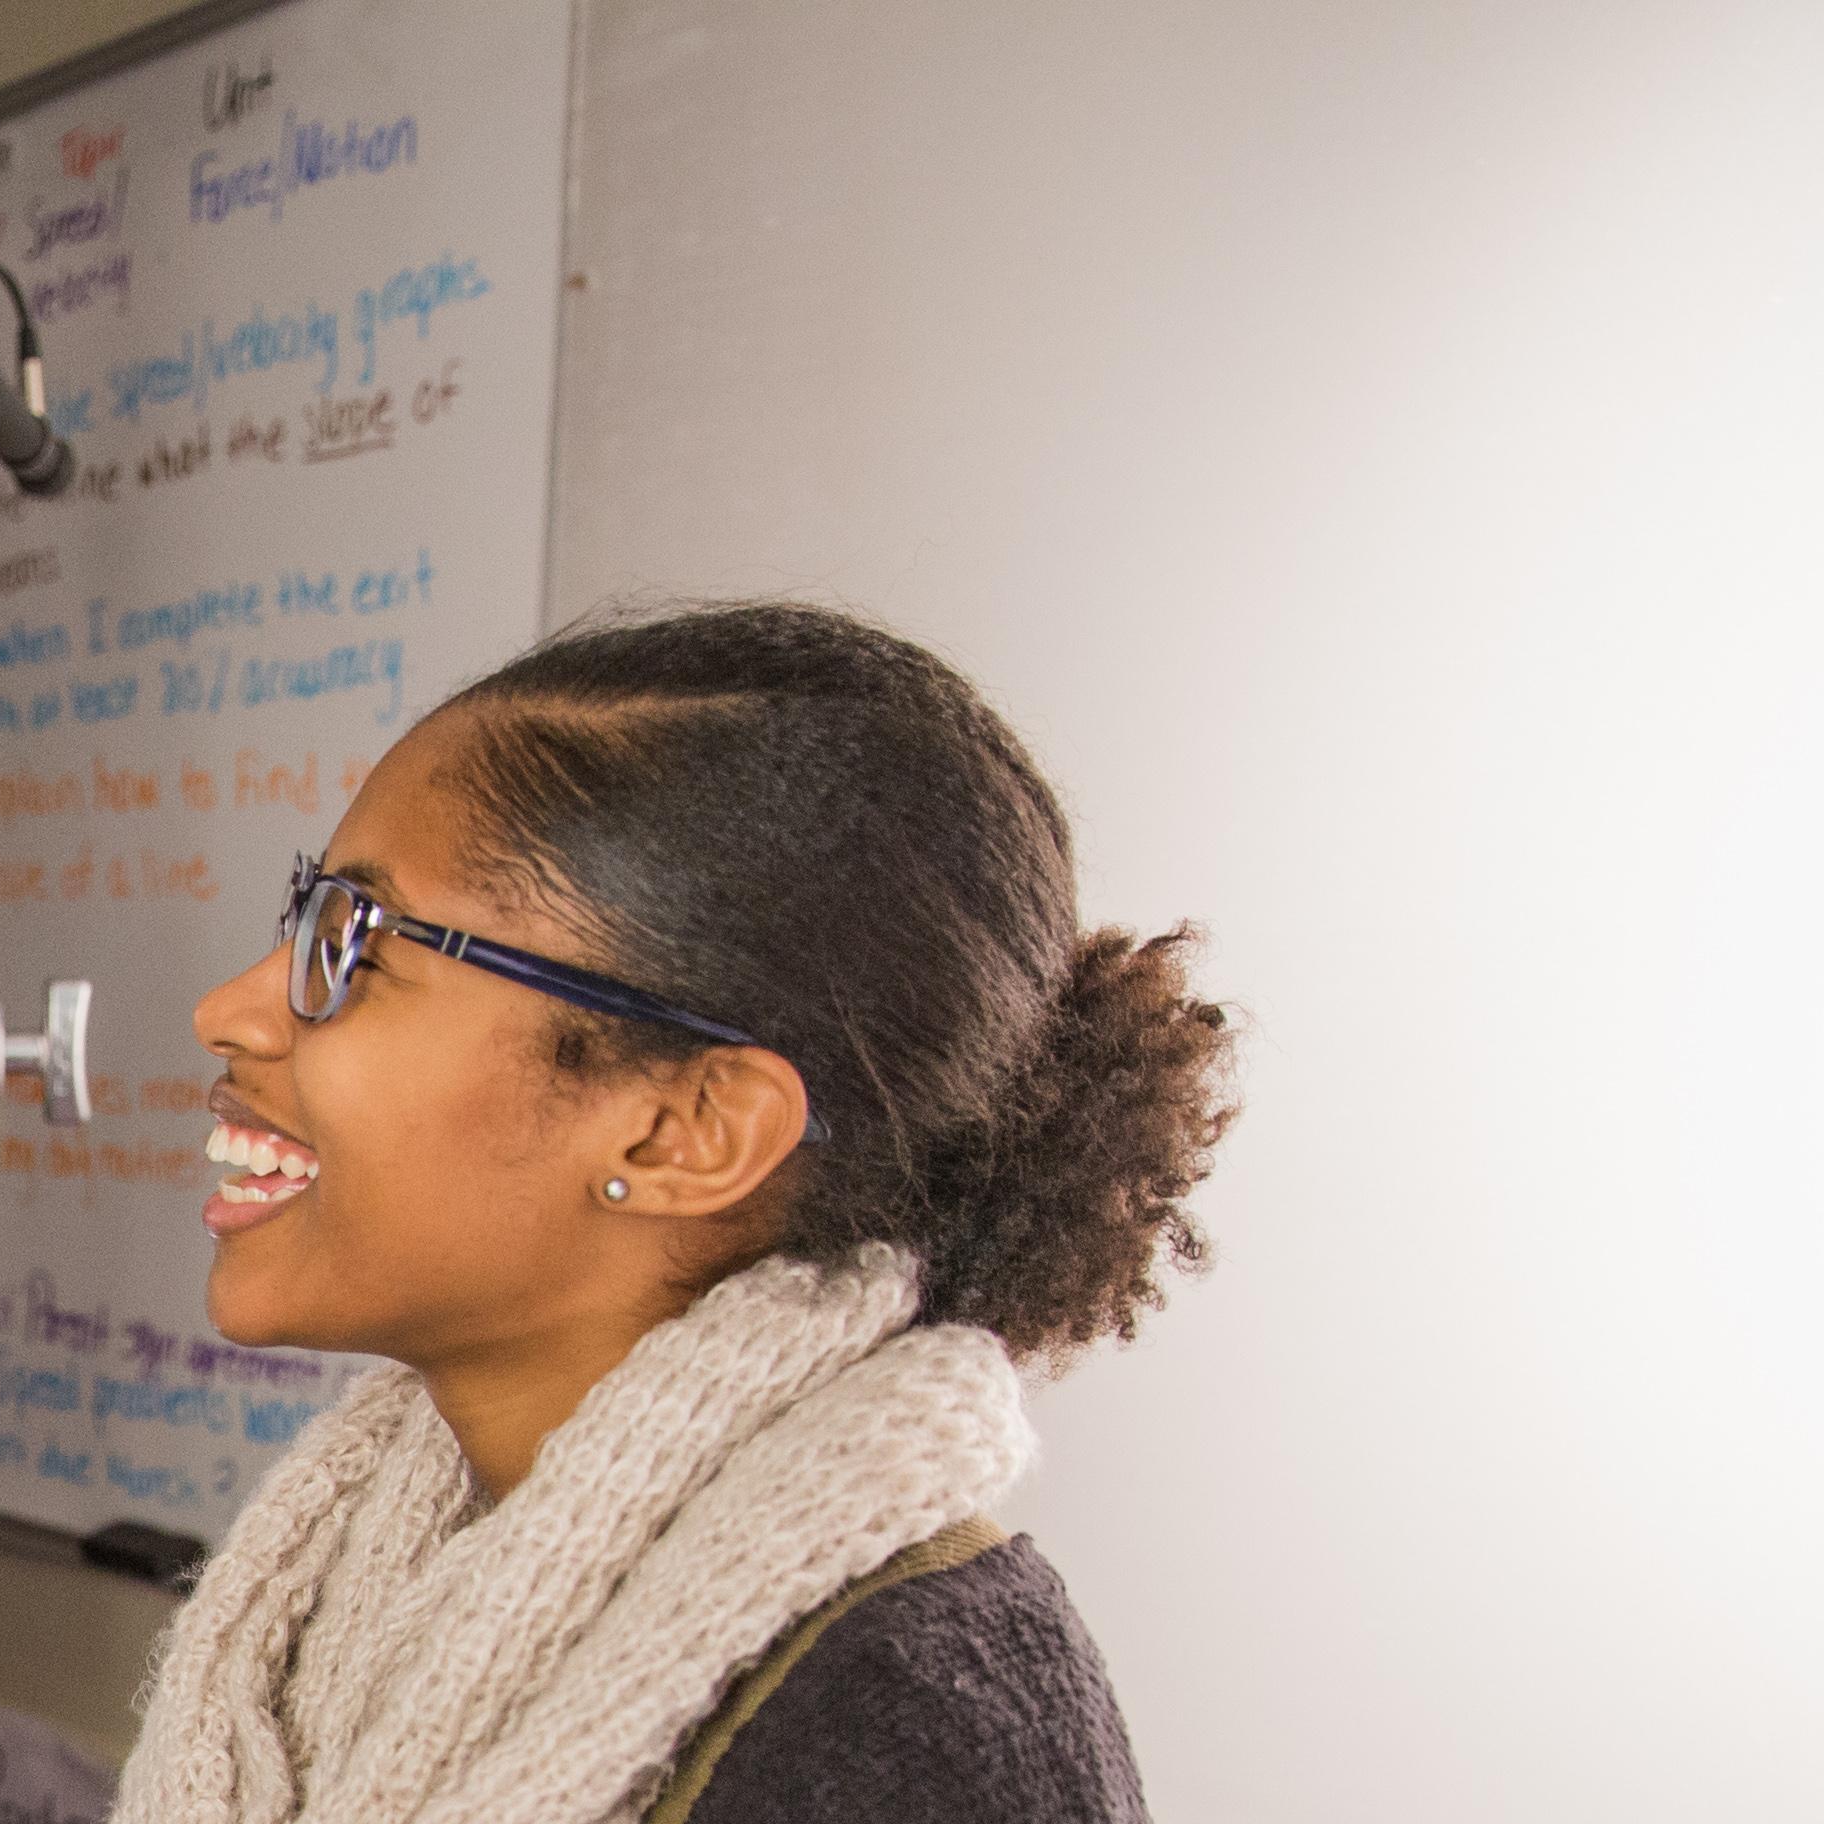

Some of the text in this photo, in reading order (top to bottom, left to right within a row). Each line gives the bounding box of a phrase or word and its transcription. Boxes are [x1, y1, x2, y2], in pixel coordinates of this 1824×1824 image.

[412, 355, 461, 424] of
[88, 598, 108, 656] I
[278, 567, 340, 615] the
[92, 756, 159, 813] how
[180, 760, 216, 812] to
[234, 746, 319, 815] find
[62, 840, 95, 898] of
